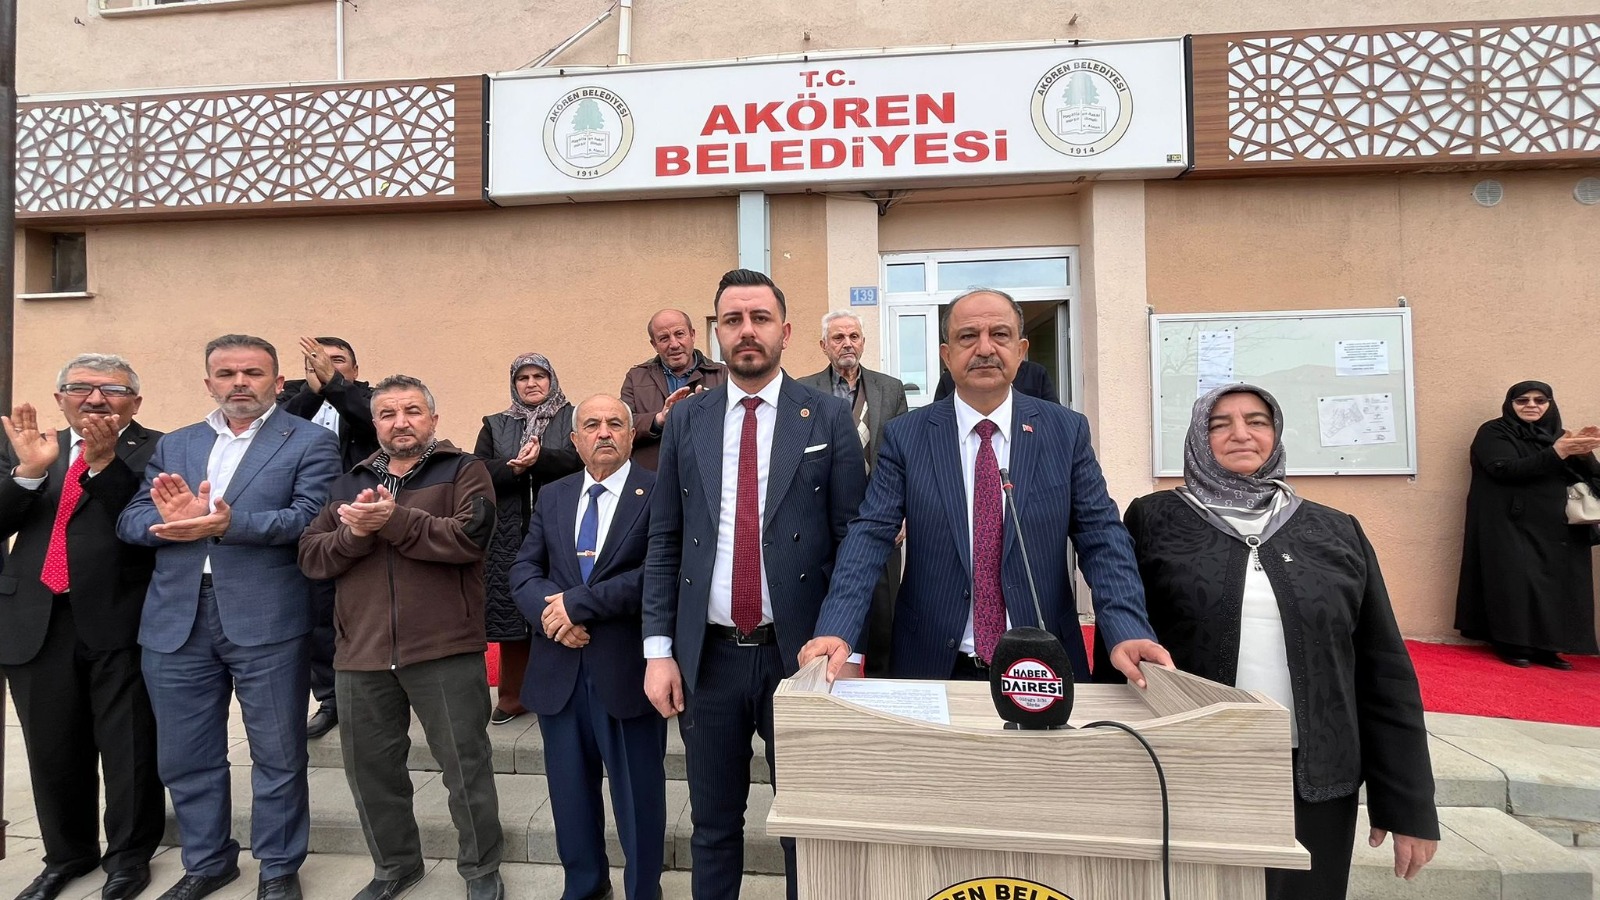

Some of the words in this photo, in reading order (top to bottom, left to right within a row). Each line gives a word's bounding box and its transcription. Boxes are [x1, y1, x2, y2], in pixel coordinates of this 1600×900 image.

[800, 69, 856, 88] T.C.
[701, 92, 956, 136] AKÖREN
[1070, 146, 1095, 154] 1914
[576, 169, 599, 177] 1914
[853, 289, 875, 301] 139
[1013, 668, 1048, 678] HABER
